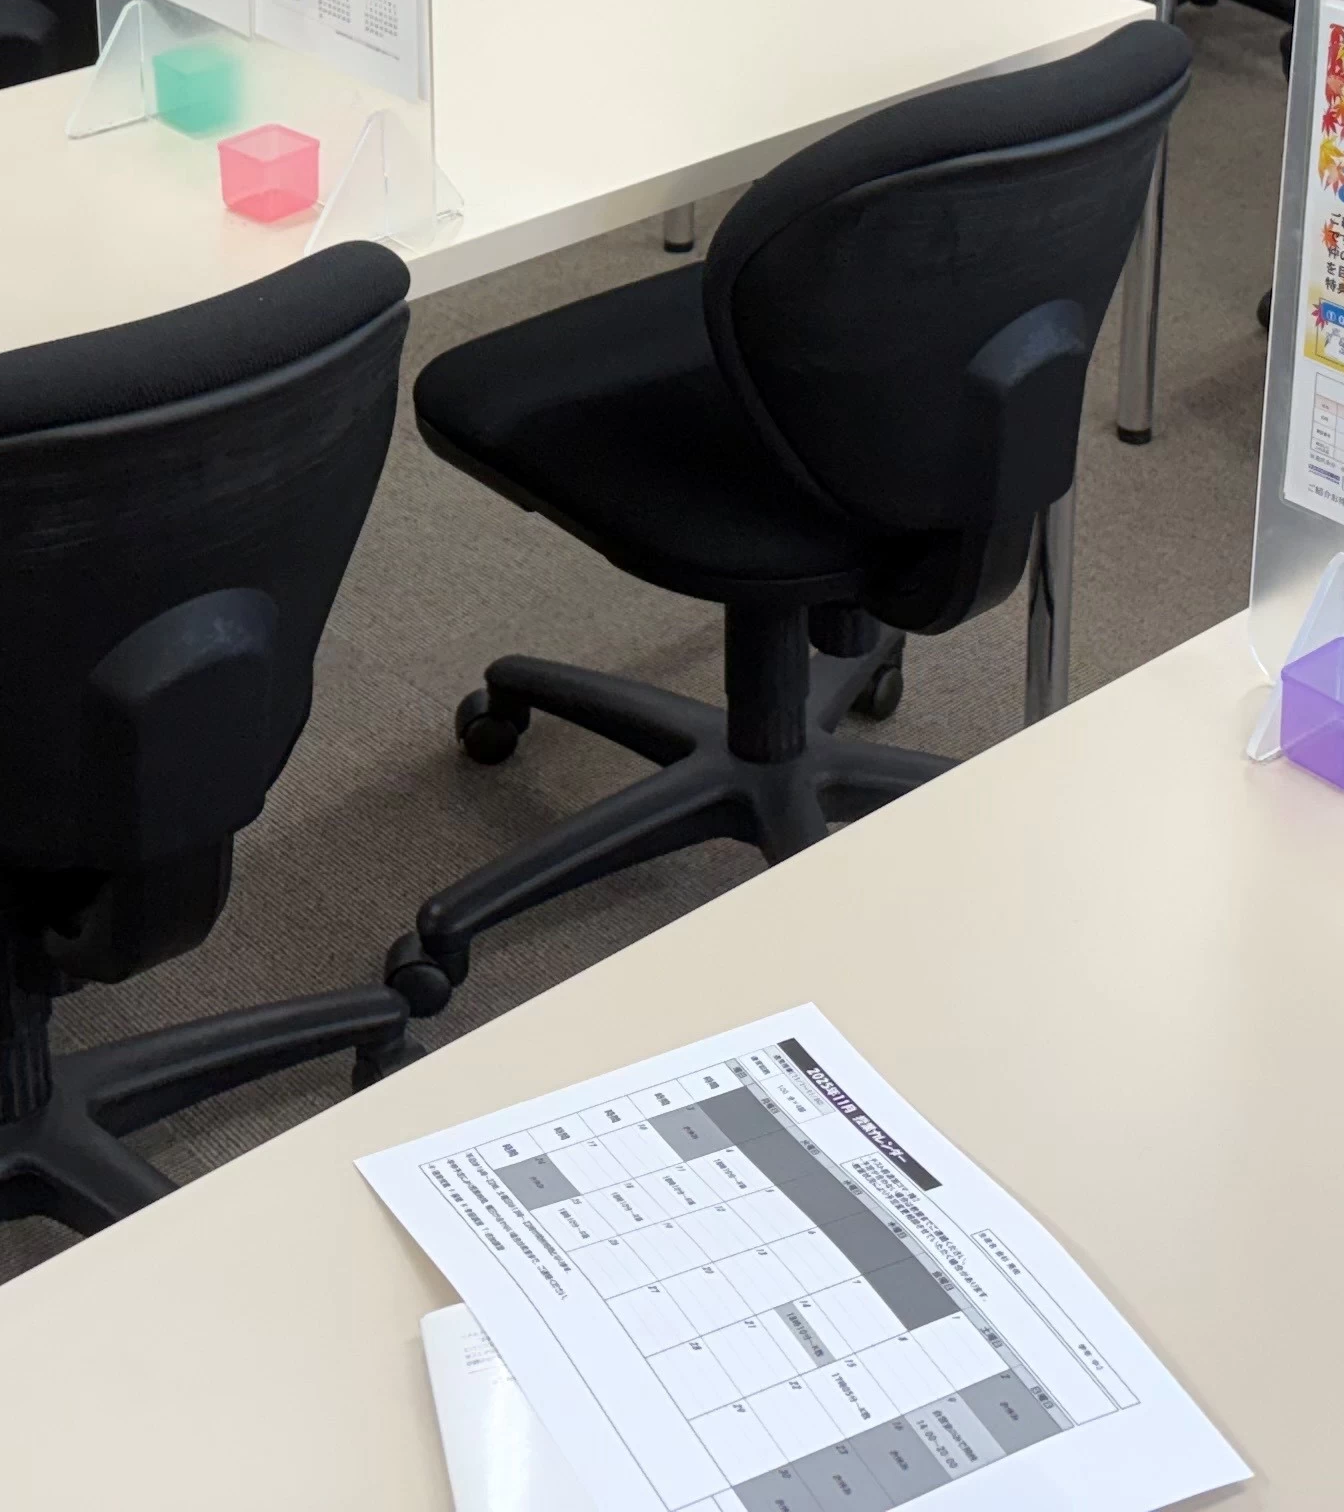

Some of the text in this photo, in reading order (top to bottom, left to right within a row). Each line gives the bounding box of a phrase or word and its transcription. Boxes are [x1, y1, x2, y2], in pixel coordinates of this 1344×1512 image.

[804, 1066, 857, 1114] 2025年11月
[850, 1113, 909, 1166] 授業カレンダー
